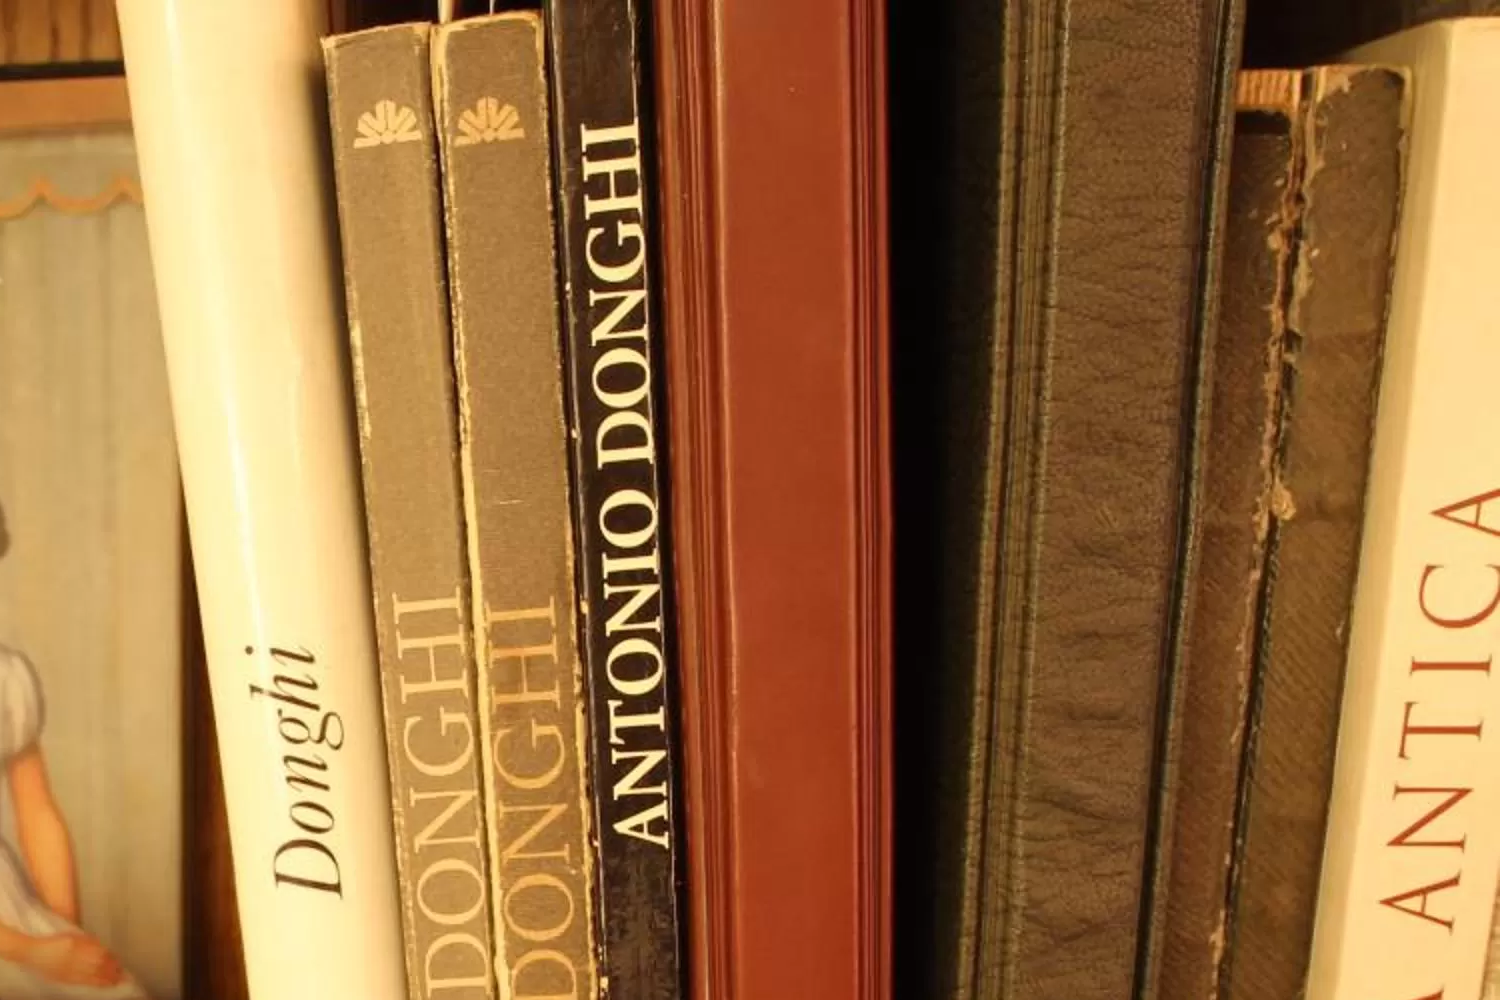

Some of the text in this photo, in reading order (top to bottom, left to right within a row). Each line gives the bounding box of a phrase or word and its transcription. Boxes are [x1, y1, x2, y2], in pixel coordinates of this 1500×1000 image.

[581, 117, 669, 849] ANTONIO DONGHI
[245, 645, 344, 900] Donghi
[392, 586, 492, 998] DONGHI
[1378, 487, 1500, 933] ANTICA
